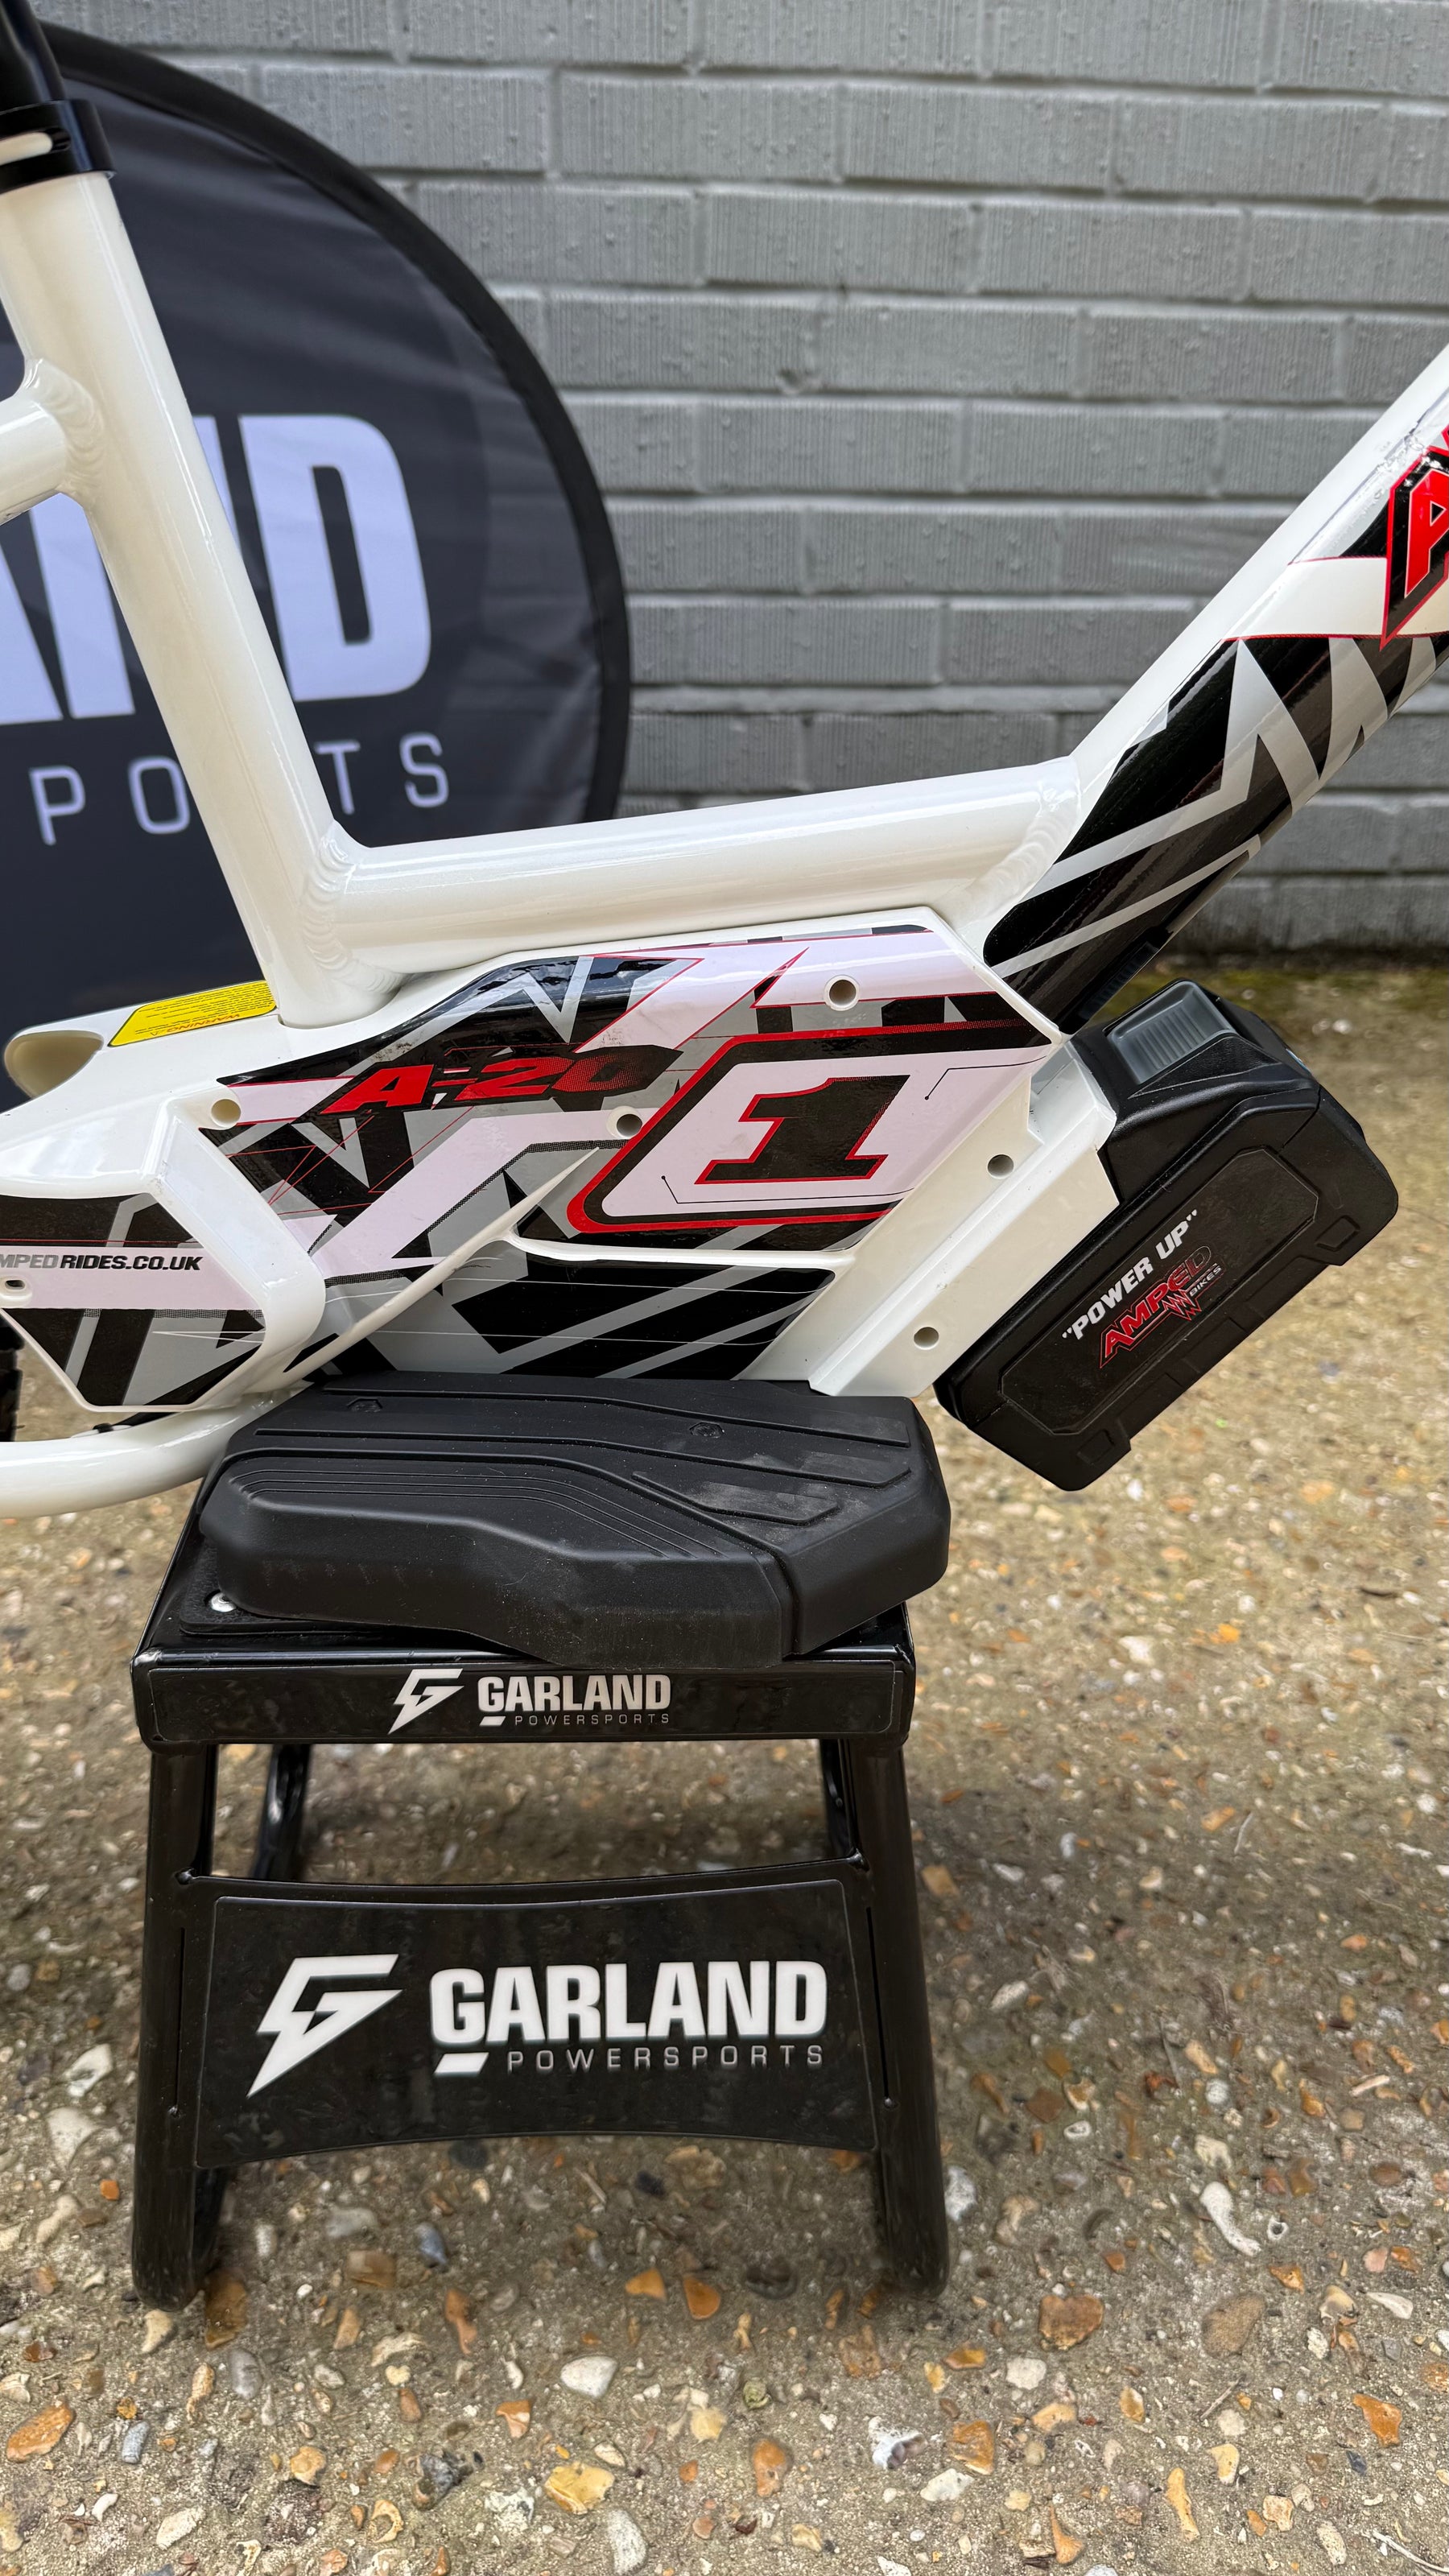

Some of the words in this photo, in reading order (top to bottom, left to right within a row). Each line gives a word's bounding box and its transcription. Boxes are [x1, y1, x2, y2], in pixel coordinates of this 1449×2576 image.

[29, 731, 449, 847] POTS
[694, 1074, 911, 1185] 1
[1104, 1245, 1212, 1359] AMPED
[1189, 1264, 1223, 1297] BIKES
[477, 1674, 671, 1712] GARLAND
[514, 1713, 670, 1726] POWERSPORTS
[429, 1960, 828, 2046] GARLAND
[506, 2045, 824, 2074] POWERSPORTS
